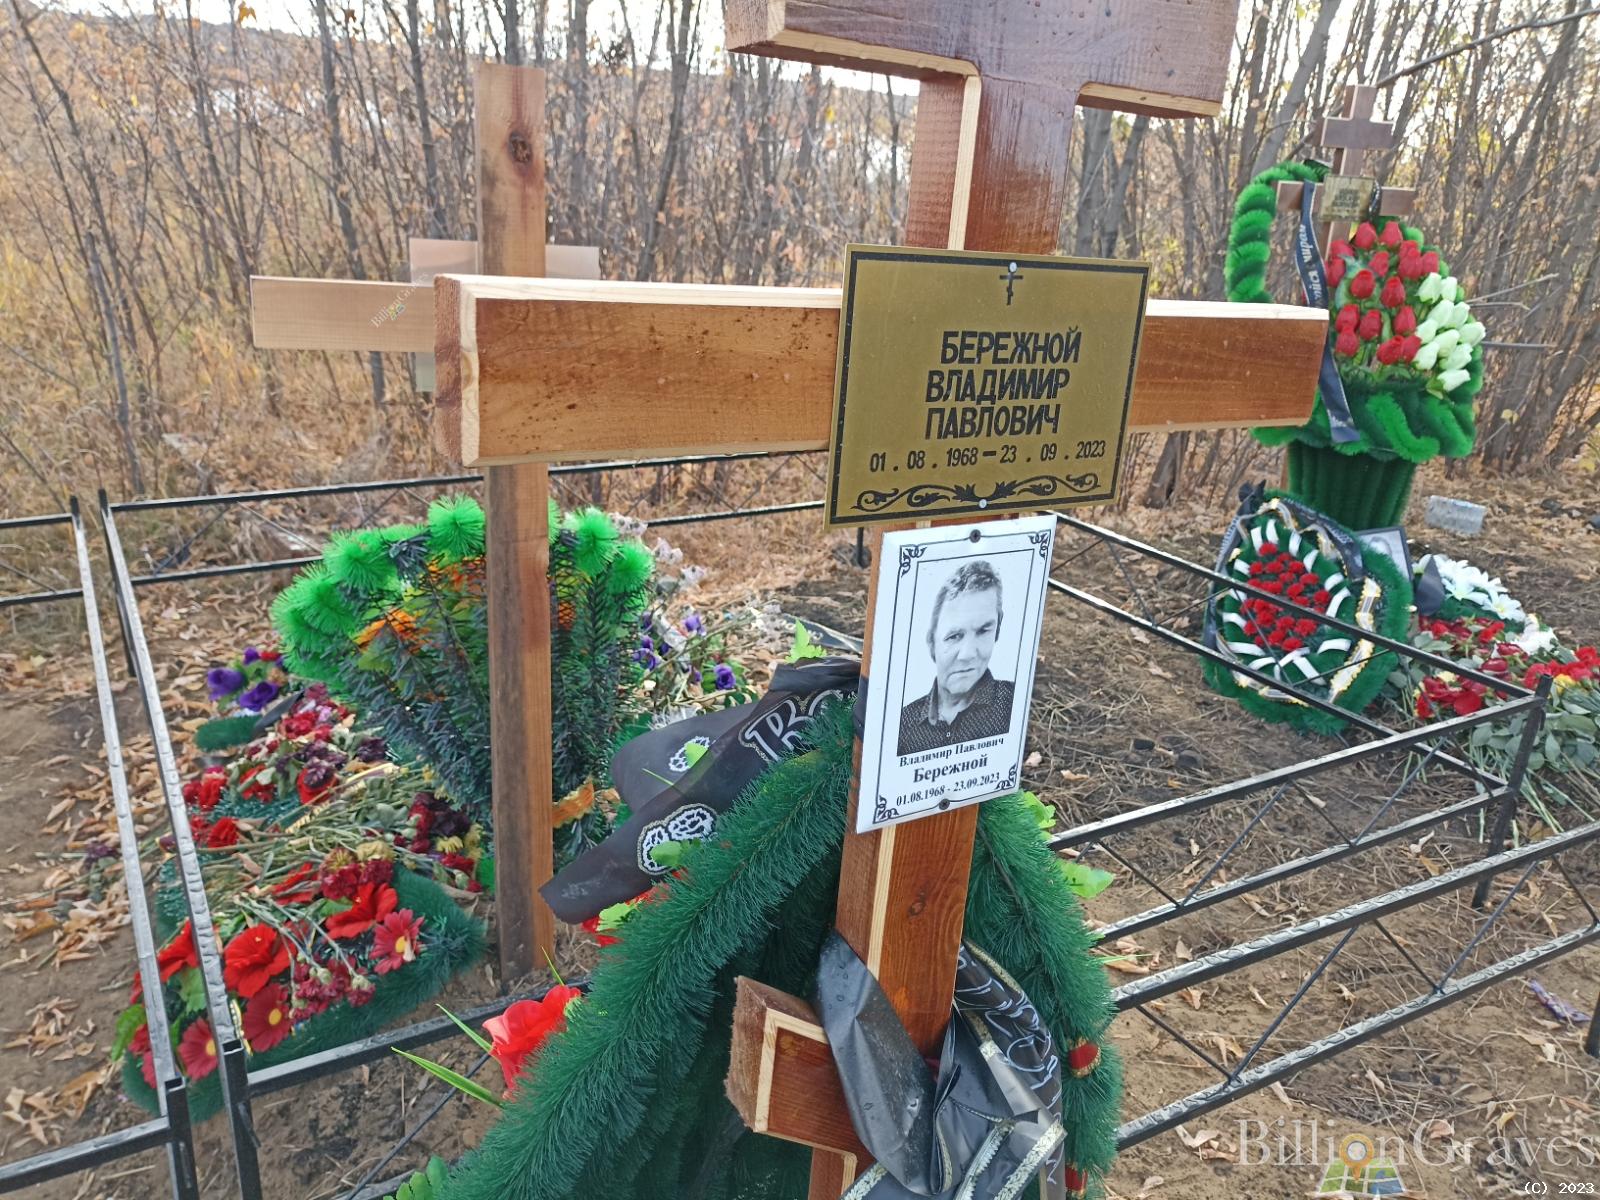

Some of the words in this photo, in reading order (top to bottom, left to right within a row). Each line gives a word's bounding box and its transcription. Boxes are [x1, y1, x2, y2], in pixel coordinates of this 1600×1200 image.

[941, 326, 1082, 365] БЕРЕЖНОЙ
[925, 369, 1071, 406] ВЛАДИМИР
[925, 404, 1061, 440] ПАВЛОВИЧ
[899, 749, 953, 767] Владимир
[955, 737, 1004, 754] Павлович
[912, 753, 988, 783] Бережной
[896, 784, 946, 807] 01.08.1968
[953, 772, 1000, 793] 23.09.2023
